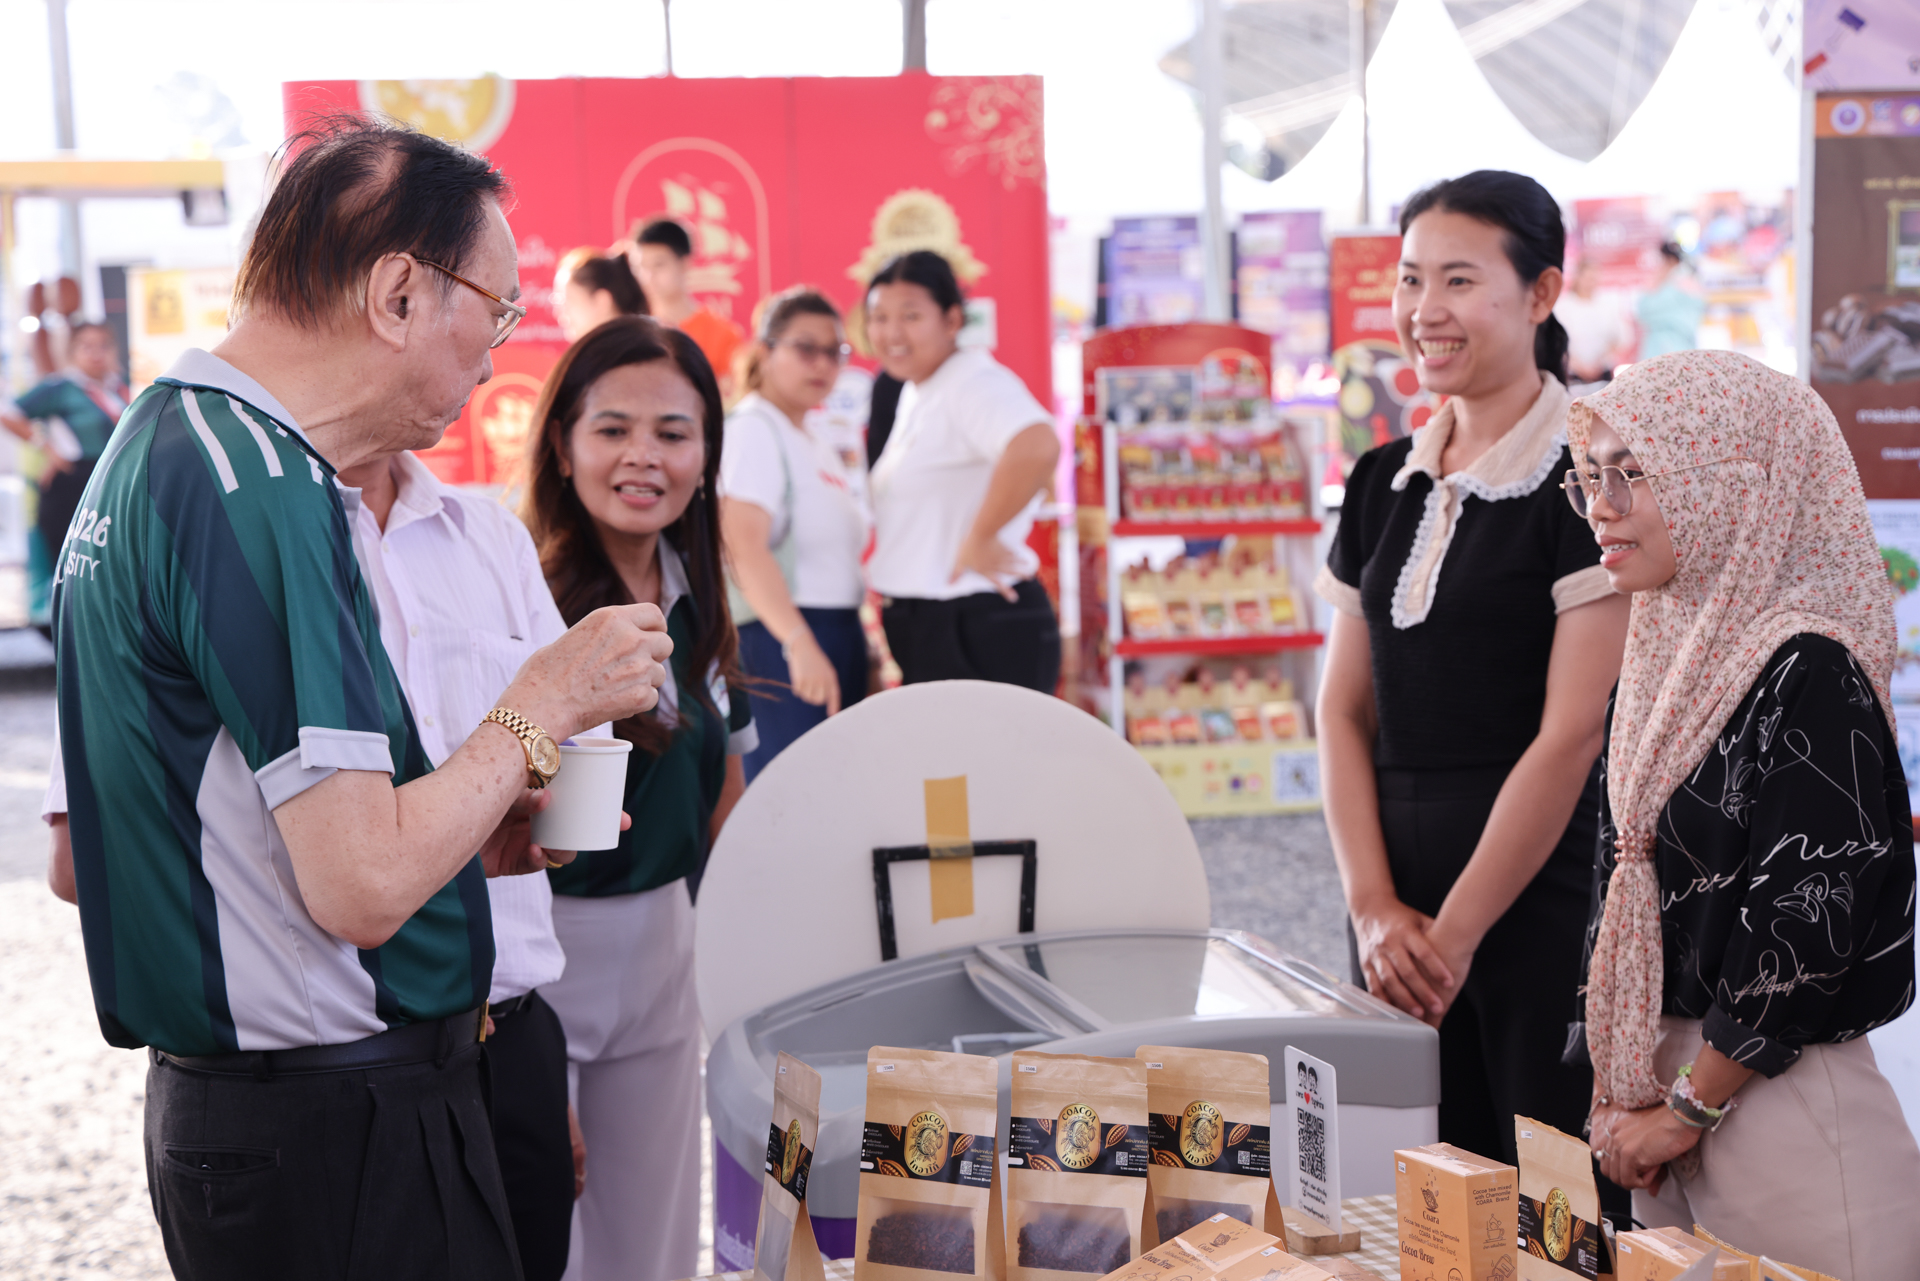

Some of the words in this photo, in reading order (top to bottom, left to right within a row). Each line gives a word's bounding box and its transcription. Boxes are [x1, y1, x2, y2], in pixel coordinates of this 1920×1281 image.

[1062, 1106, 1096, 1123] COACOA
[1186, 1103, 1220, 1121] COACOA
[911, 1113, 945, 1131] COACOA
[1485, 1190, 1511, 1199] Chamomile
[1497, 1184, 1512, 1192] mixed
[1476, 1198, 1493, 1206] COARA
[1548, 1191, 1569, 1212] COACOA
[1422, 1210, 1440, 1225] Coara
[1403, 1216, 1414, 1226] Cocoa
[1420, 1223, 1432, 1233] mixed
[1440, 1230, 1460, 1243] Chamomile
[1419, 1229, 1431, 1239] COARA
[1433, 1234, 1444, 1244] Brand
[1141, 1252, 1159, 1265] Cocoa
[1401, 1240, 1418, 1259] Cocoa
[1419, 1247, 1435, 1265] Brew
